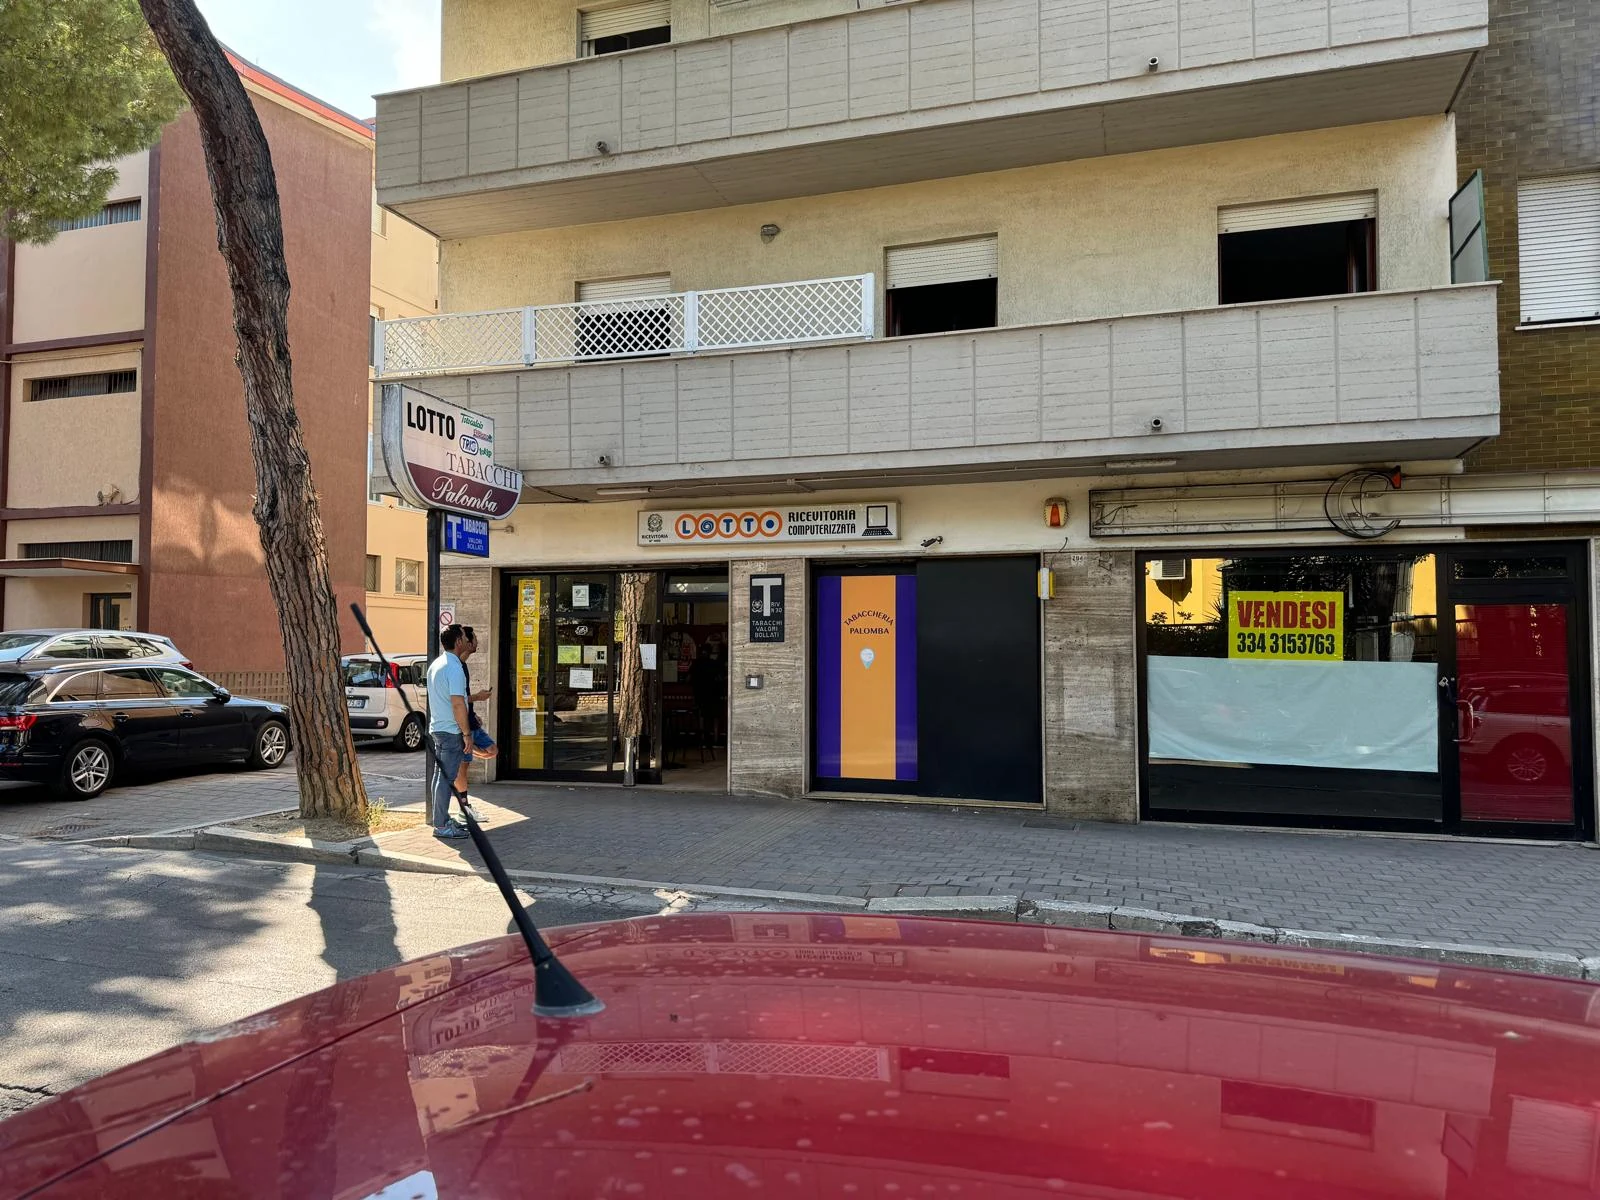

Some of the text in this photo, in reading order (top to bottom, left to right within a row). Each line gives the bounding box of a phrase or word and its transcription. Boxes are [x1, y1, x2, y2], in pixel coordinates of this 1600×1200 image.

[407, 402, 455, 440] LOTTO
[446, 452, 519, 490] TABACCHI
[432, 476, 498, 513] Palomba
[463, 518, 487, 535] TABACCHI
[676, 513, 781, 538] LOTTO
[788, 509, 856, 522] RICEVITORIA
[788, 523, 856, 535] COMPUTERIZZATA
[844, 610, 894, 626] TABACCHERIA
[1237, 600, 1336, 629] VENDESI
[1237, 632, 1335, 654] 334 3153763
